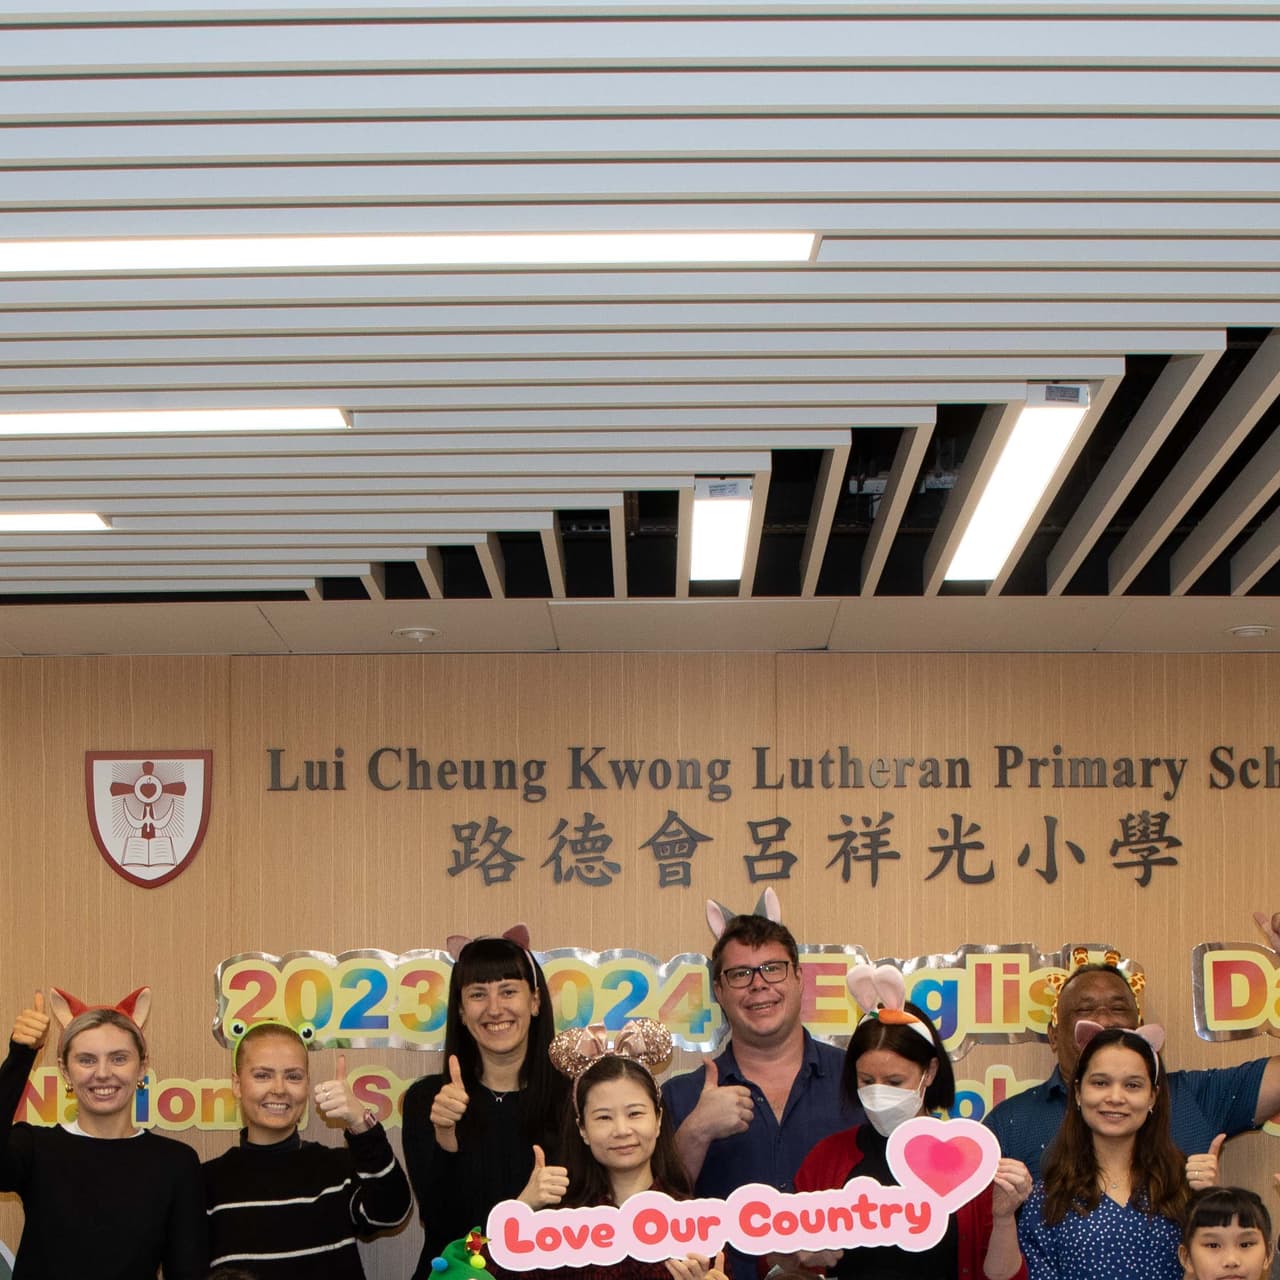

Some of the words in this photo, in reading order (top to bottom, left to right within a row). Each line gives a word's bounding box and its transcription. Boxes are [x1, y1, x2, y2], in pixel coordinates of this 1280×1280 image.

[265, 746, 347, 792] Lui
[367, 746, 547, 804] Cheung
[567, 745, 732, 802] Kwong
[751, 746, 972, 791] Lutheran
[993, 744, 1189, 802] Primary
[447, 809, 1183, 888] 路德會呂祥光小學
[800, 962, 1057, 1041] Eglis
[504, 1219, 614, 1254] Love
[632, 1210, 719, 1245] Our
[738, 1195, 931, 1237] Country
